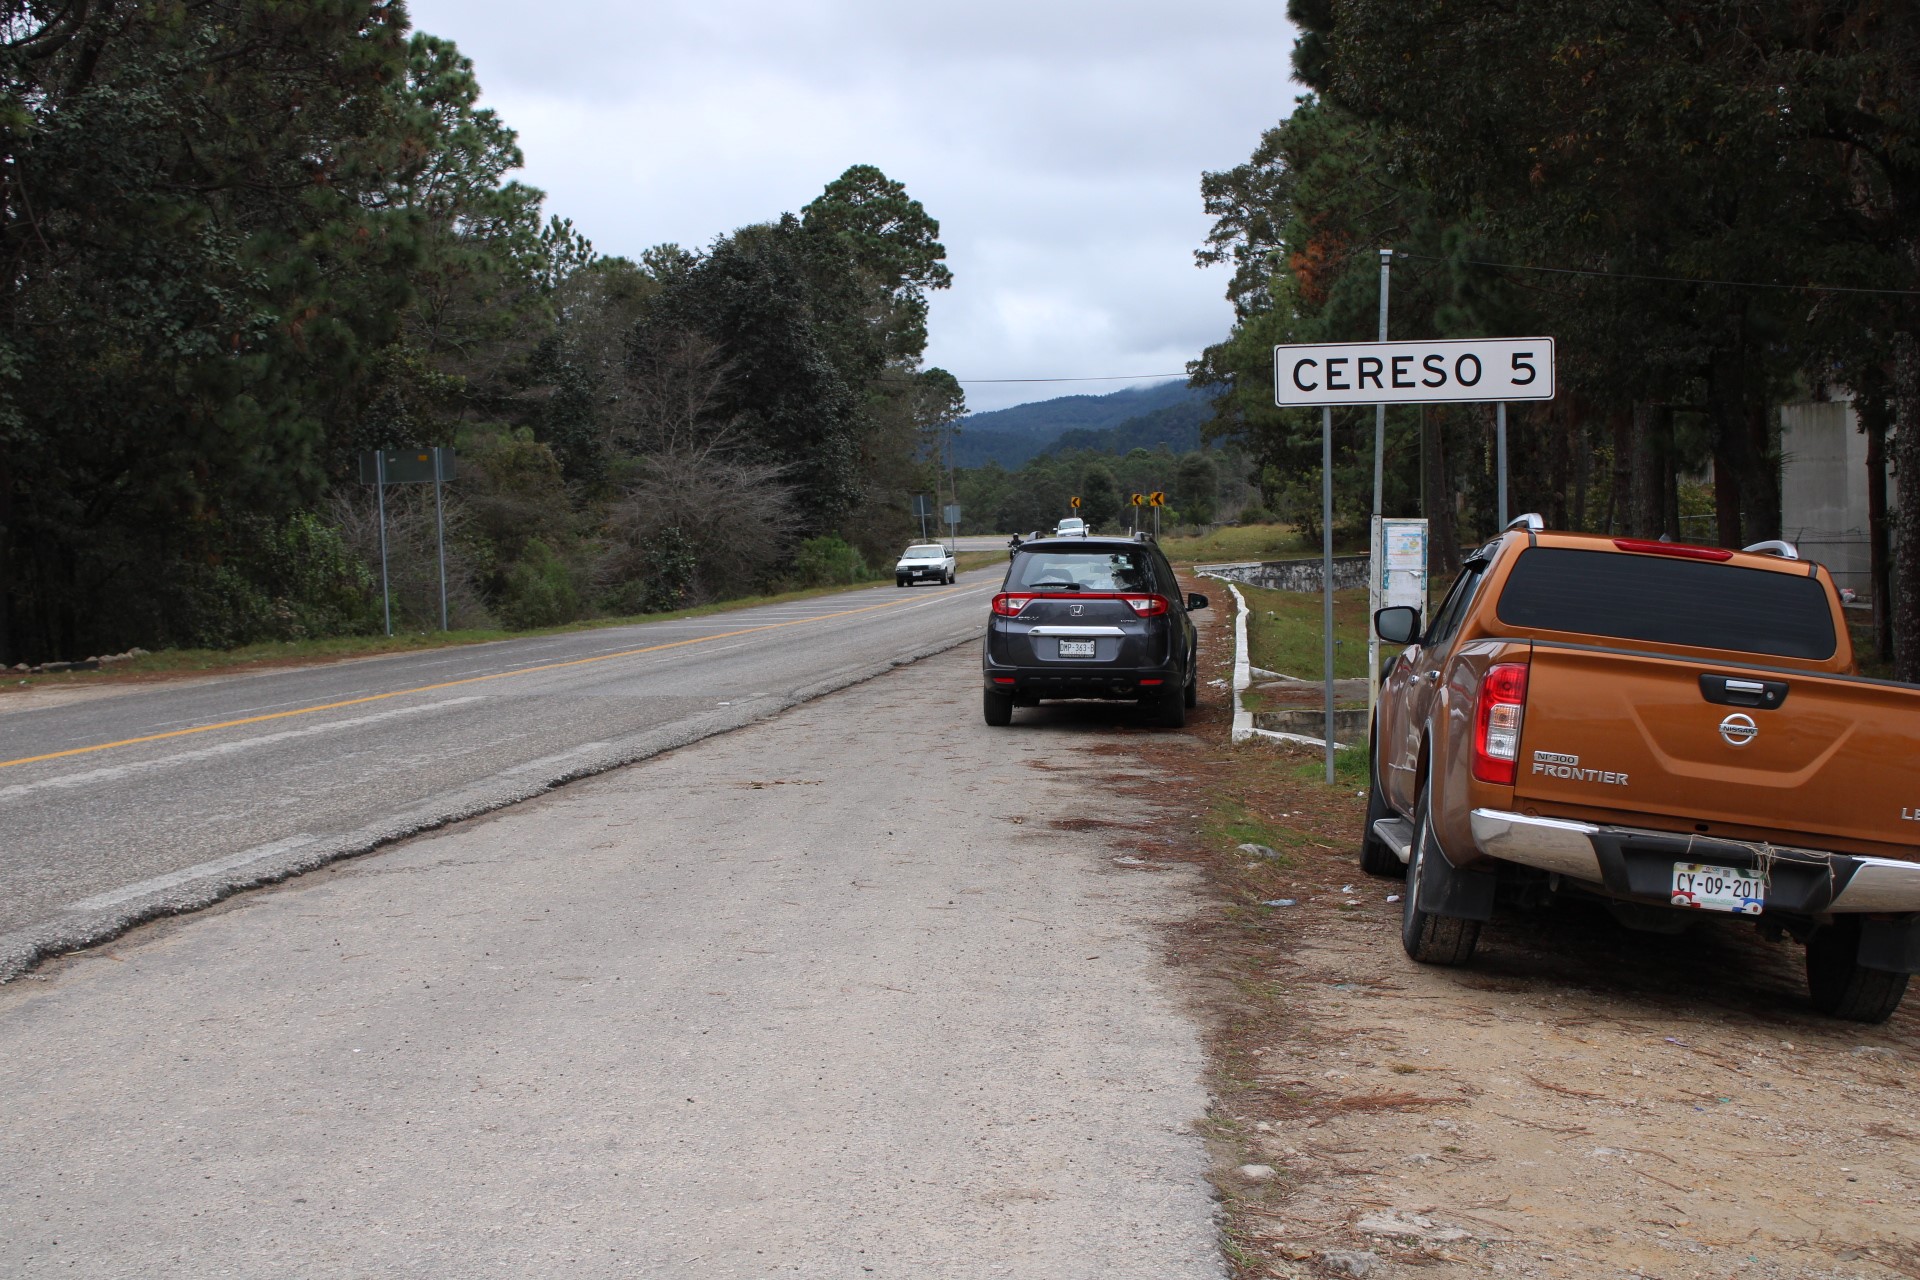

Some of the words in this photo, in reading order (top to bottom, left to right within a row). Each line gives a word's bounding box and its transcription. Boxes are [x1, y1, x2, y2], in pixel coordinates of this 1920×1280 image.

[1293, 353, 1482, 392] CERESO
[1510, 352, 1536, 386] 5
[1723, 726, 1755, 735] NISSAN
[1537, 752, 1576, 764] NP300
[1532, 762, 1629, 786] FRONTIER
[1677, 873, 1760, 900] CY-09-201
